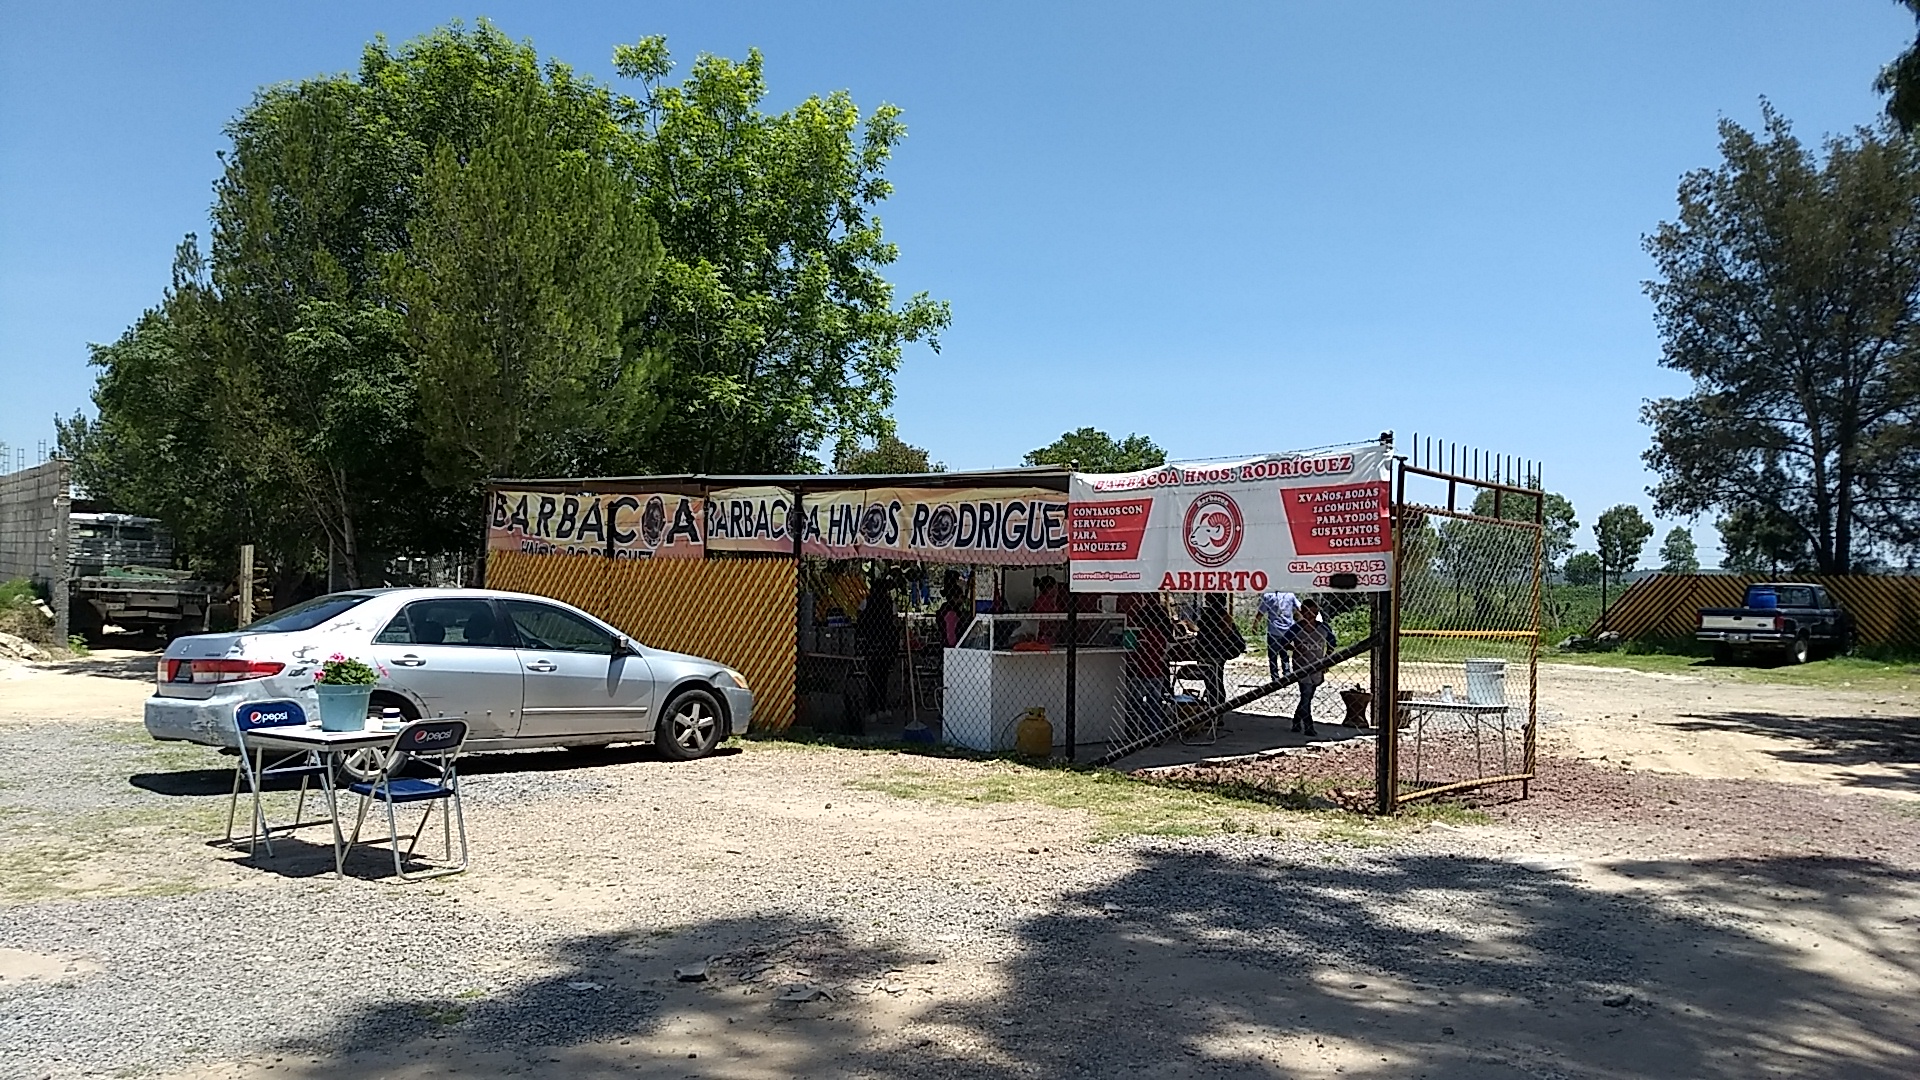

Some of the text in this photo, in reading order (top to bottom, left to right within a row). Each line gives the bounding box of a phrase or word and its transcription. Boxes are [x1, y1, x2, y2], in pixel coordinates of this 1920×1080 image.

[1093, 455, 1353, 491] BARBACOA HNOS. RODRÍGUEZ
[1298, 488, 1379, 503] XV AÑOS, BODAS
[1073, 505, 1143, 517] CONTAMOS CON
[1324, 499, 1379, 513] COMUNIÓN
[493, 492, 701, 546] BARBACOA
[828, 501, 902, 546] HNOS
[1073, 519, 1116, 528] SERVICIO
[1316, 512, 1379, 525] PARA TODOS
[1073, 531, 1098, 540] PARA
[1311, 524, 1380, 537] SUS EVENTOS
[1072, 542, 1127, 552] BANQUETES
[1329, 536, 1382, 548] SOCIALES
[1288, 559, 1386, 573] CEL. 415 153 74 52
[1158, 570, 1268, 591] ABIERTO
[1370, 574, 1387, 585] 25
[262, 711, 288, 724] pepsi
[426, 729, 453, 742] pepsi
